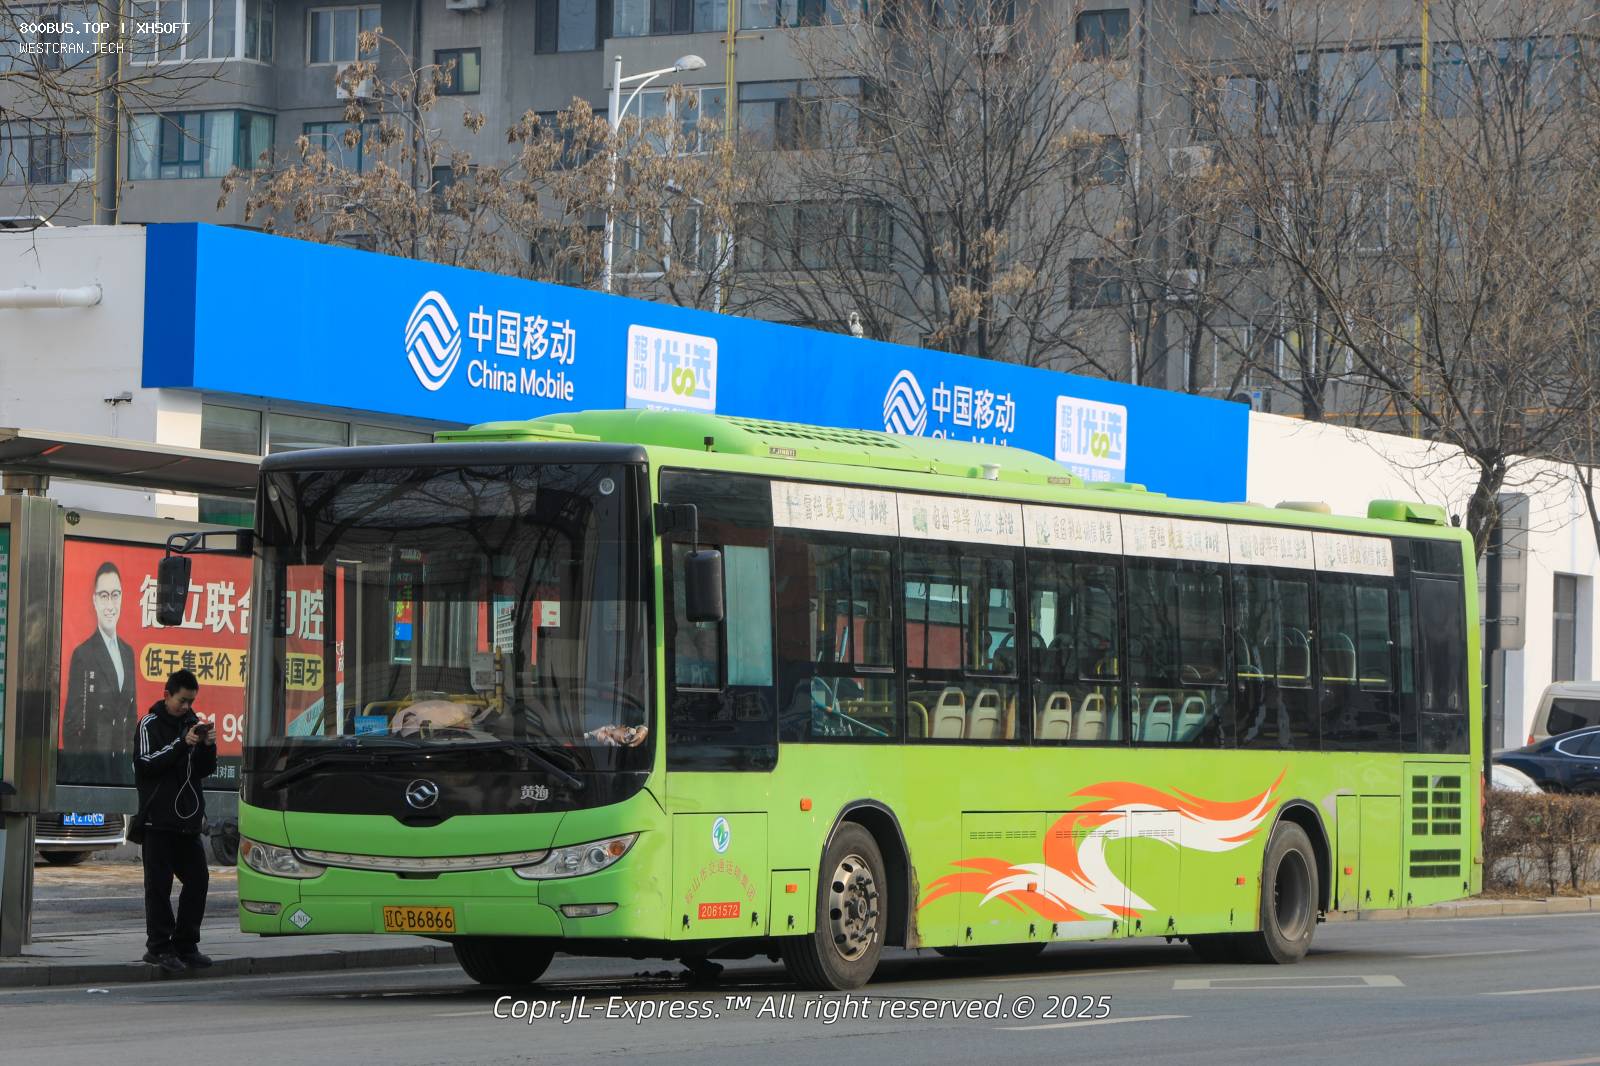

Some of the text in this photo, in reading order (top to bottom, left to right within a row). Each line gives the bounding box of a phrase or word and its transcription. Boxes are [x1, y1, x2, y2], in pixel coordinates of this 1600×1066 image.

[468, 304, 577, 365] 中国移动
[467, 359, 574, 402] China Mobile
[632, 334, 649, 391] 移动
[653, 337, 711, 400] 优选
[931, 381, 1016, 434] 中国移动
[1077, 407, 1122, 461] 优选
[145, 647, 231, 681] 低于集采价
[702, 904, 738, 918] 2061572
